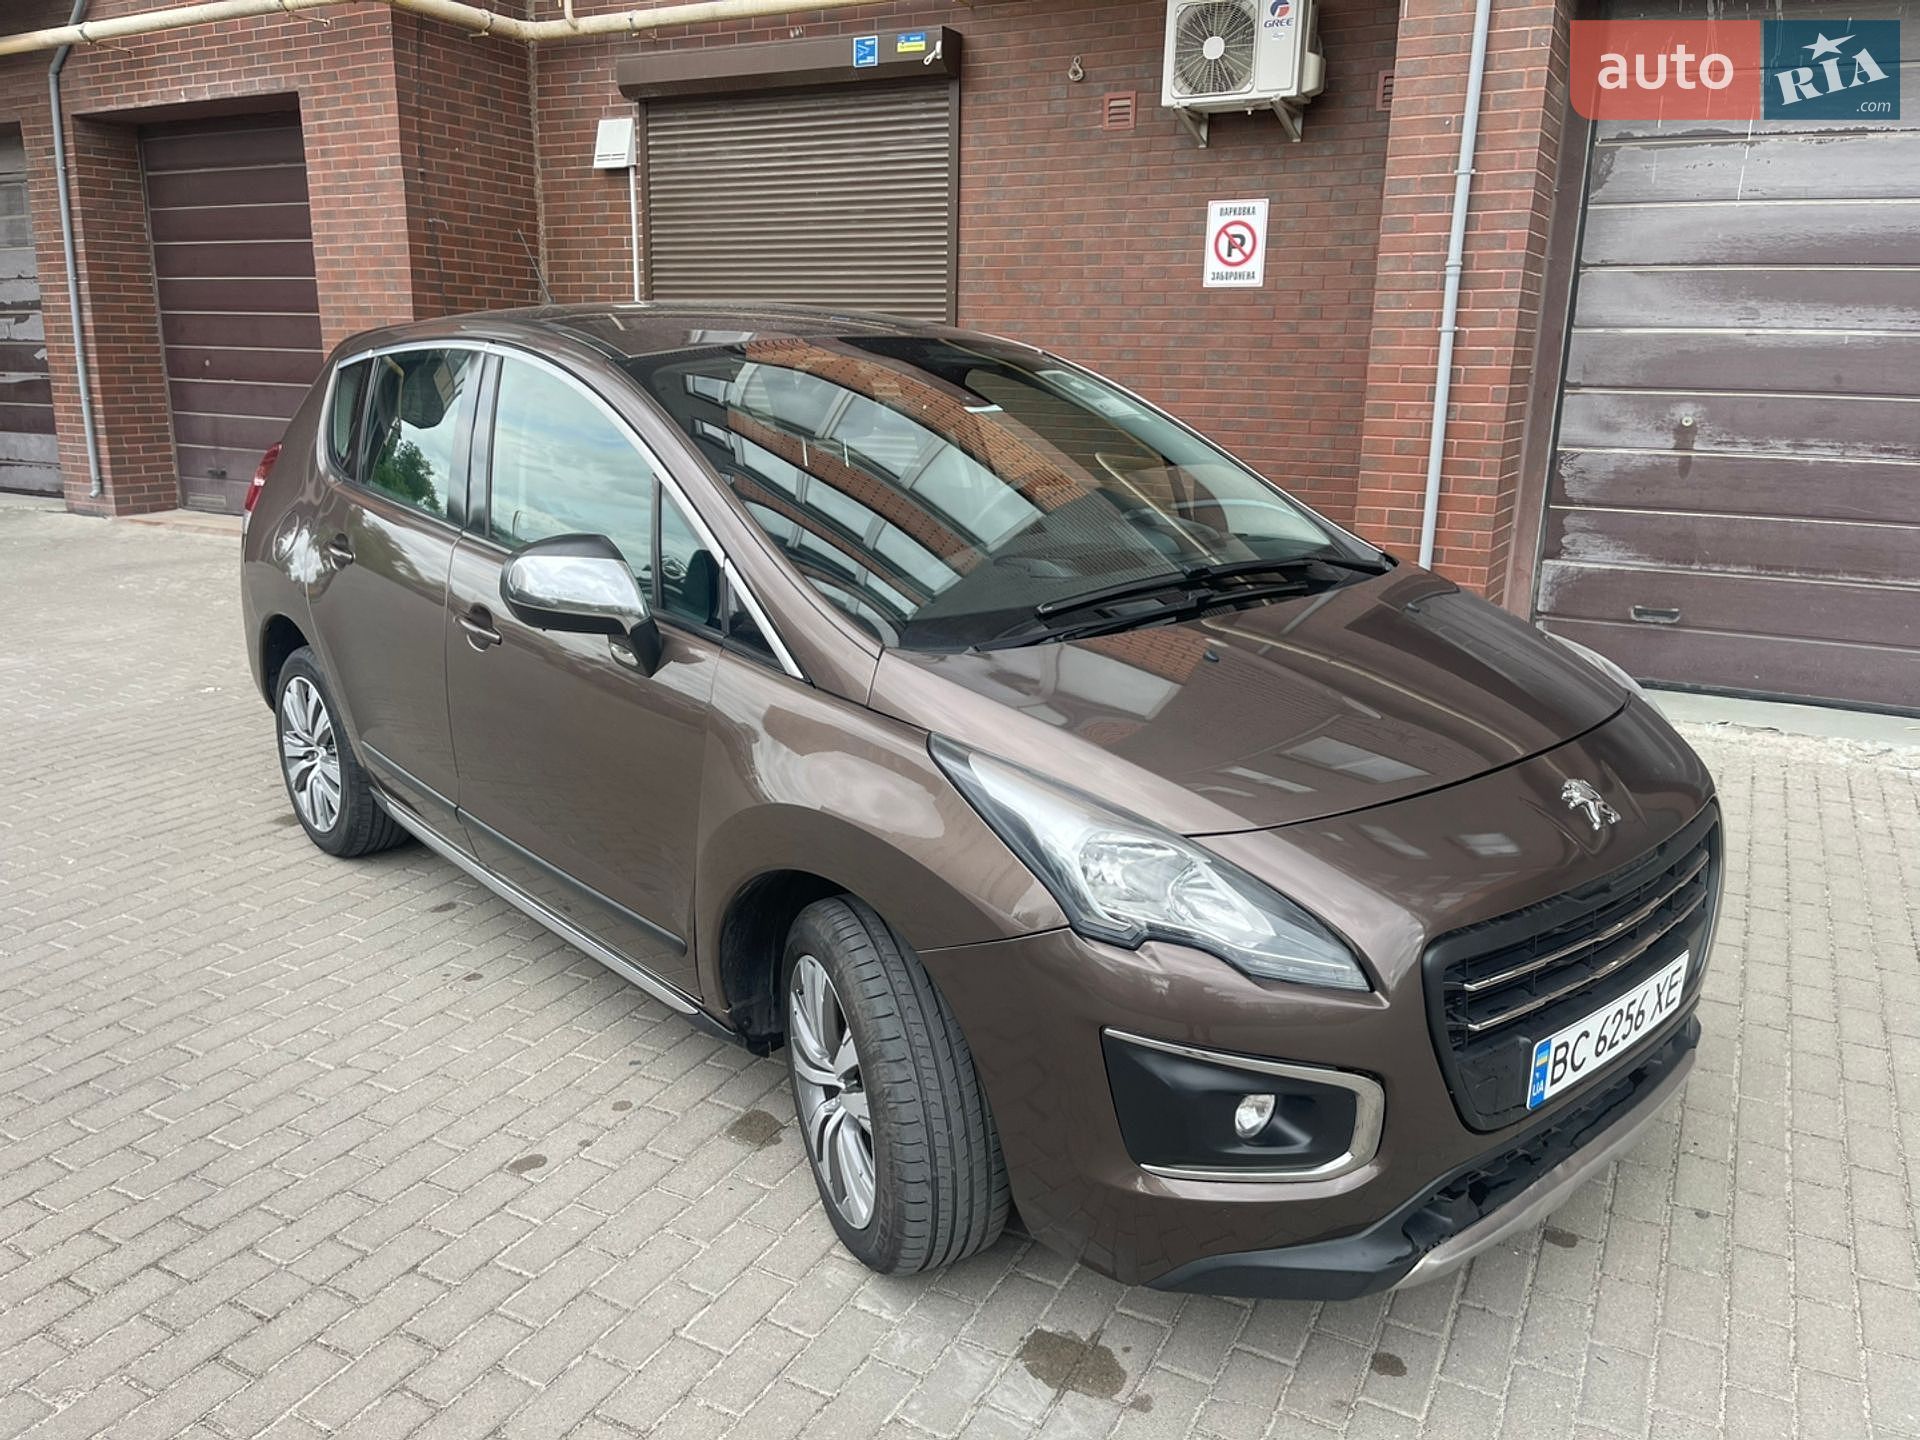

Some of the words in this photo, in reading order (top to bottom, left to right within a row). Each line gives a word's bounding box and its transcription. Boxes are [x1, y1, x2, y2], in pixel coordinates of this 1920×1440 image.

[1264, 18, 1294, 27] GREE
[1220, 206, 1256, 216] ПАРКОВКА
[1211, 271, 1256, 281] ЗАБОРОНЕНА
[1550, 1031, 1590, 1087] BC
[1594, 990, 1648, 1058] 6256
[1651, 967, 1682, 1021] XE
[1532, 1080, 1544, 1096] UA
